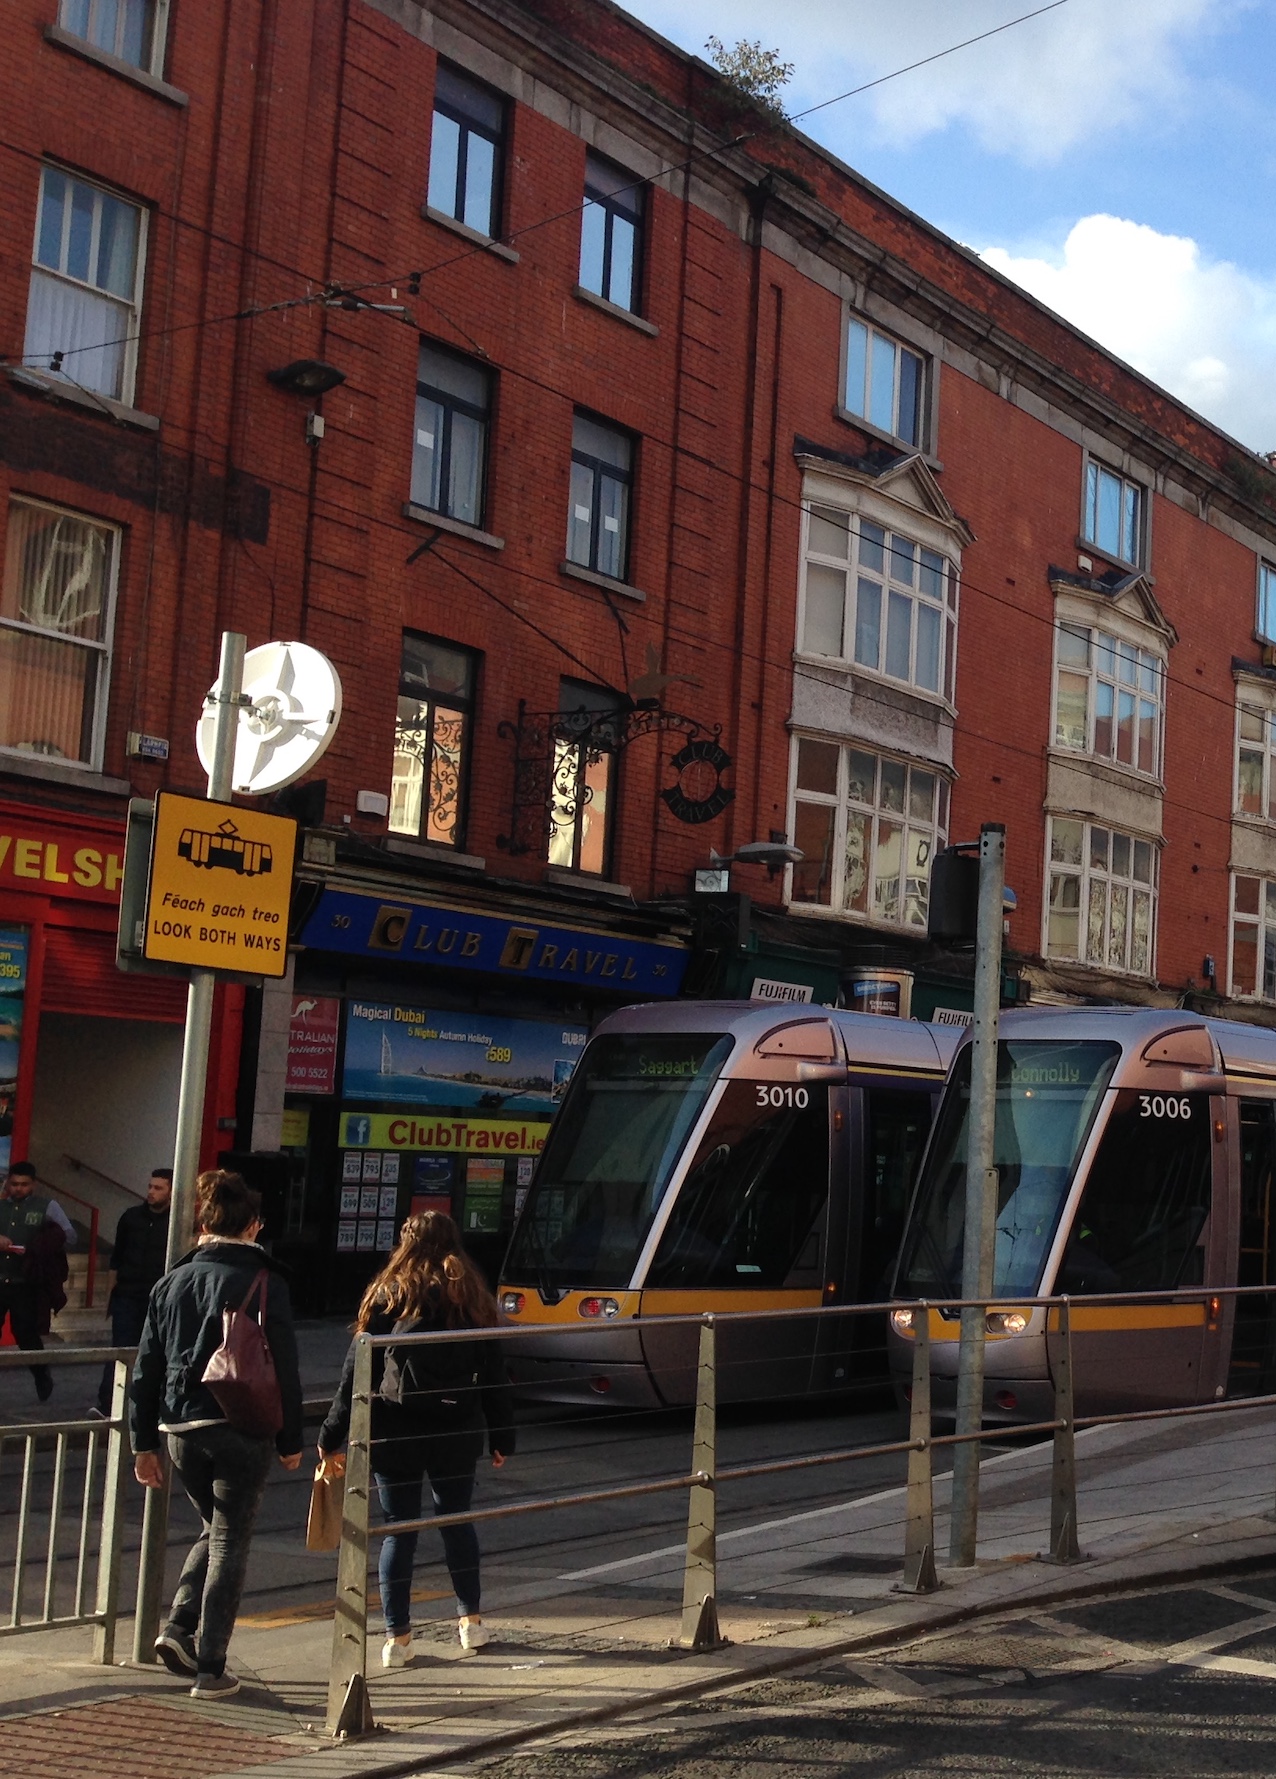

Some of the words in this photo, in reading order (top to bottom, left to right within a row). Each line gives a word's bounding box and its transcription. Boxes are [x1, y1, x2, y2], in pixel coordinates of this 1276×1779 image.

[678, 743, 723, 765] CLUB
[668, 794, 730, 822] TRAVEL
[162, 892, 205, 912] Féach
[211, 902, 246, 919] gach
[252, 907, 280, 924] treo
[153, 920, 192, 940] LOOK
[199, 929, 236, 945] BOTH
[244, 933, 281, 952] WAYS
[379, 914, 482, 957] CLUB
[512, 935, 638, 980] TRAVEL
[758, 983, 807, 1003] FUJIFILM
[352, 1004, 391, 1021] Magical
[393, 1007, 425, 1023] Dubai
[414, 1028, 438, 1040] Nights
[439, 1030, 467, 1041] Autumn
[467, 1033, 493, 1046] Holiday
[288, 1046, 334, 1056] olidays
[291, 1066, 307, 1077] 500
[308, 1067, 328, 1079] 5522
[638, 1055, 699, 1075] Saggart
[755, 1085, 809, 1109] 3010
[1139, 1096, 1192, 1120] 3006
[388, 1119, 545, 1151] ClubTravel.ie
